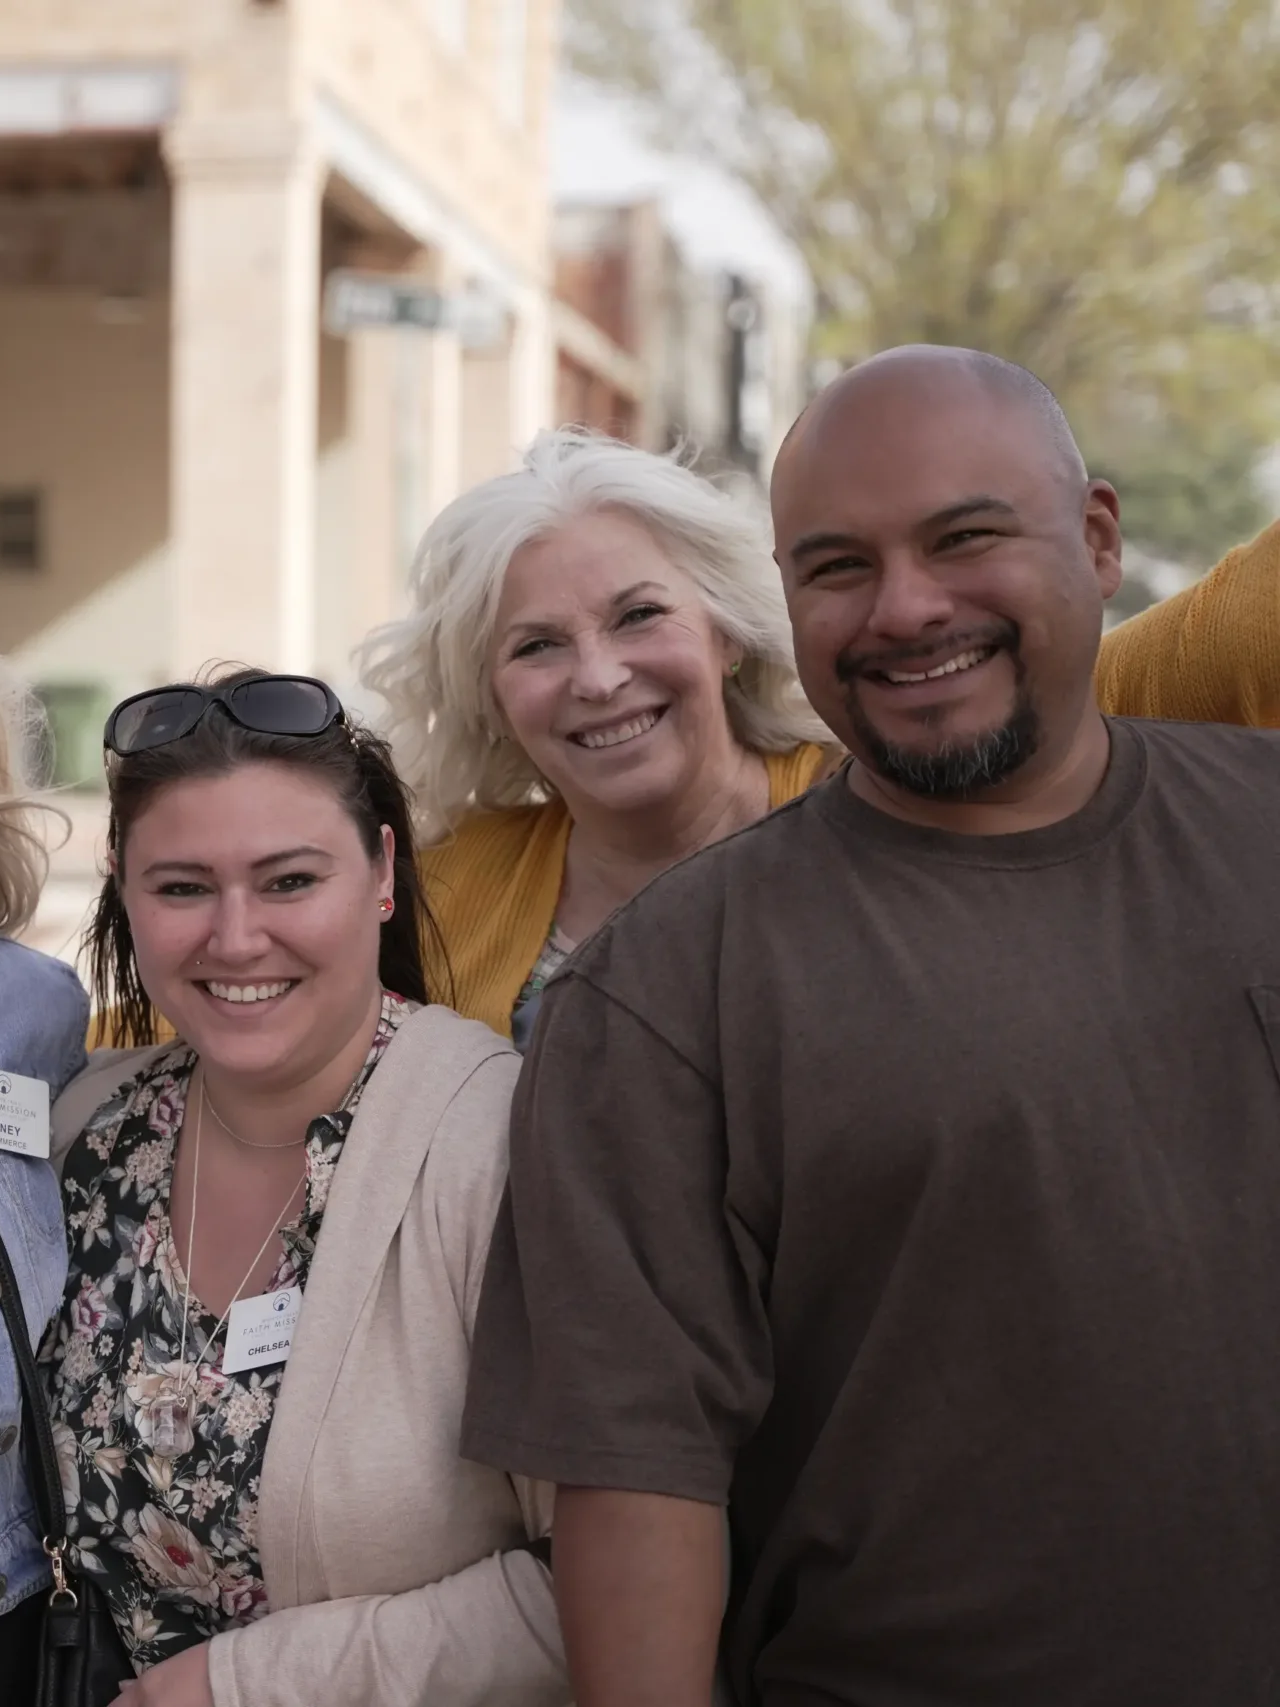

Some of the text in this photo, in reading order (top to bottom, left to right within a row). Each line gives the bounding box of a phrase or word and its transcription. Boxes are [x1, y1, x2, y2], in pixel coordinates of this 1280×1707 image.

[0, 1104, 36, 1118] MISSION
[243, 1324, 270, 1336] FAITH
[274, 1316, 296, 1328] MISS
[248, 1340, 290, 1356] CHELSEA
